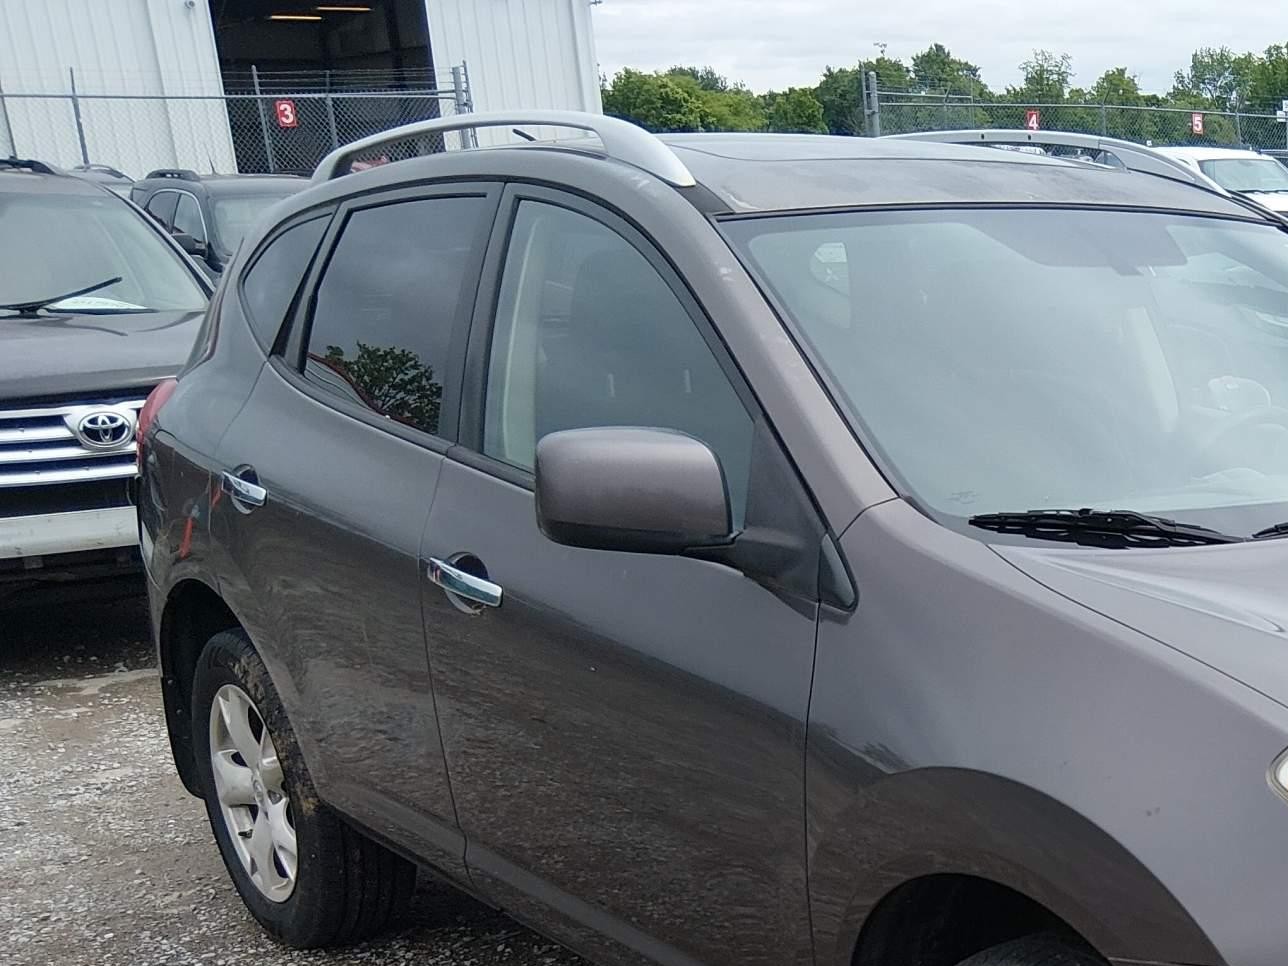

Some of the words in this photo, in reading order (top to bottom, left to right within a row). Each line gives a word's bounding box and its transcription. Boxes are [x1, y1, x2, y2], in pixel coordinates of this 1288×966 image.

[279, 103, 294, 124] 3
[1028, 113, 1039, 130] 4
[1193, 116, 1202, 131] 5
